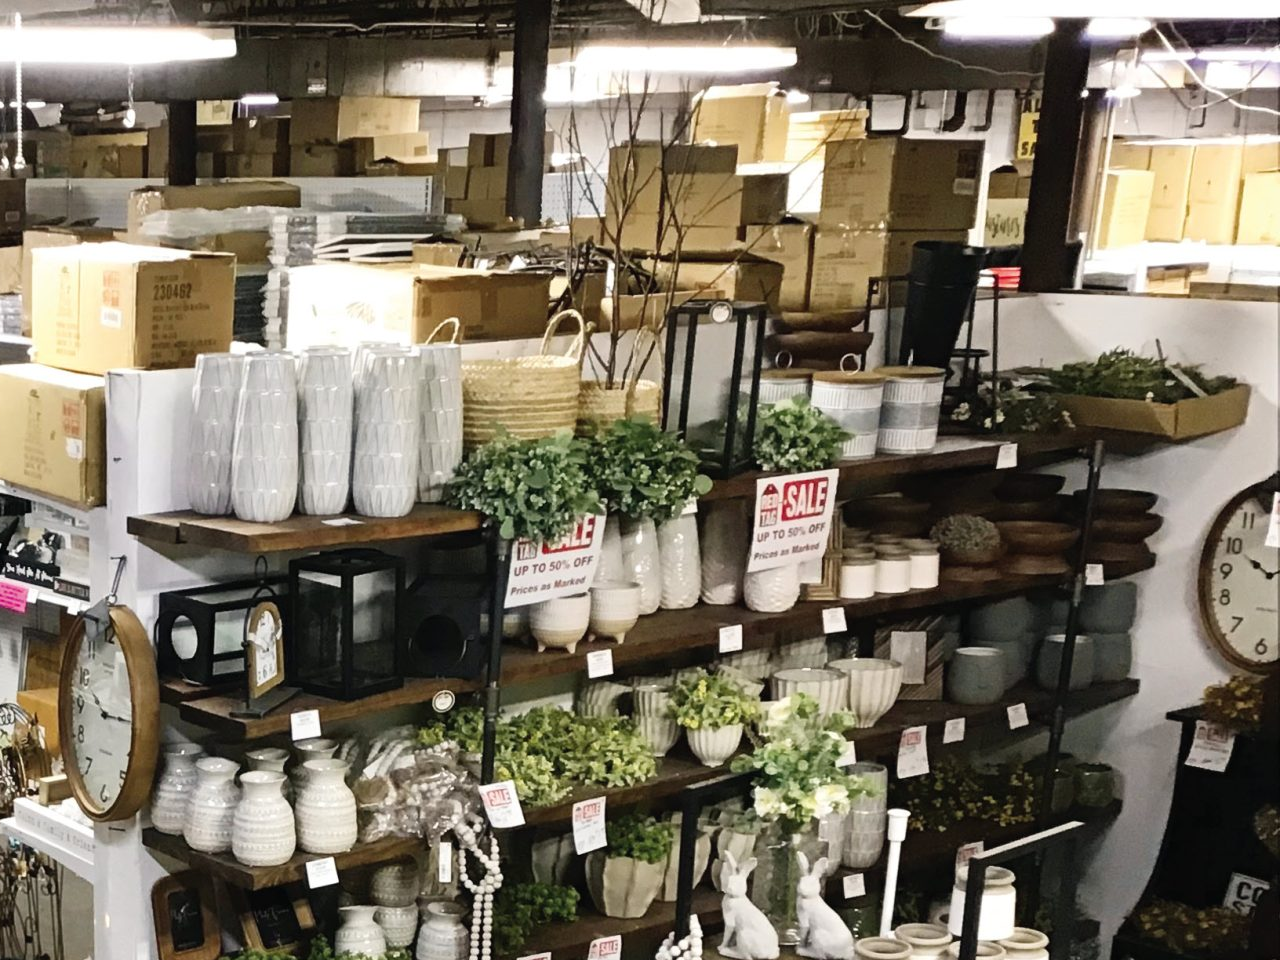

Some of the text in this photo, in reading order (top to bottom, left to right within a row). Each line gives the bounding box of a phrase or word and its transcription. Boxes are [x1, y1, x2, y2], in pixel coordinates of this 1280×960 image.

[153, 283, 192, 301] 230462
[785, 480, 827, 518] SALE
[1242, 512, 1255, 530] 11
[756, 523, 826, 543] UP TO 50% OFF
[754, 543, 820, 560] Prices as Marked
[1226, 537, 1243, 555] 10
[514, 555, 594, 577] UP TO 50% OFF
[1220, 562, 1233, 580] 9
[510, 585, 538, 596] Prices
[553, 576, 587, 588] Marked
[1219, 589, 1231, 606] 8
[1230, 616, 1244, 633] 7
[1254, 638, 1268, 655] 6
[76, 694, 85, 714] 9
[77, 725, 85, 744] 8
[85, 756, 93, 775] 7
[600, 940, 618, 956] SALE
